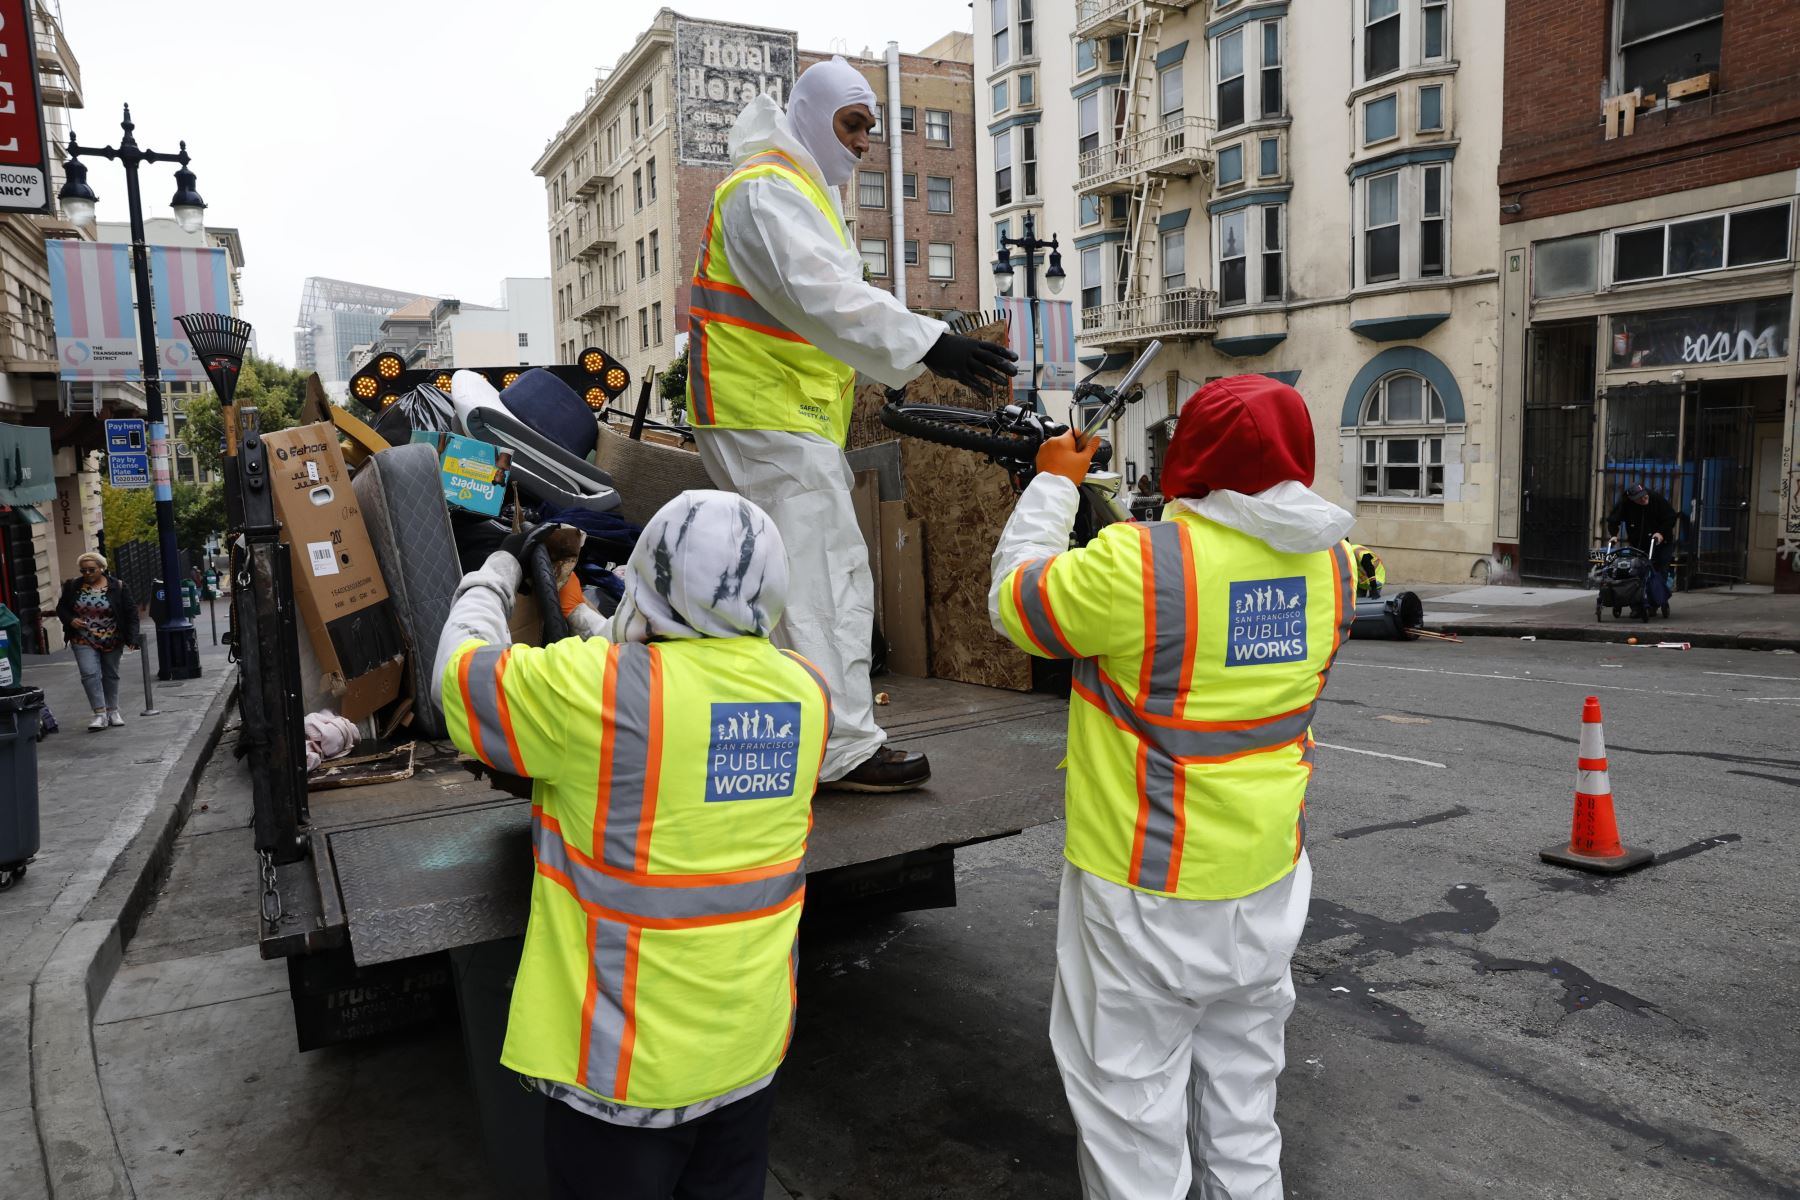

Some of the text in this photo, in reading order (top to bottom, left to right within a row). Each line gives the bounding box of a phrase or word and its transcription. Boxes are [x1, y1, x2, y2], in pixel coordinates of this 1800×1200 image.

[702, 35, 772, 74] Hotel
[693, 111, 723, 124] STEEL
[694, 131, 714, 141] 200
[699, 143, 724, 154] BATH
[0, 173, 38, 185] ROOMS
[108, 422, 142, 431] Pay here
[112, 456, 126, 464] Pay
[450, 476, 495, 500] Pampers
[60, 490, 72, 534] HOTEL
[1235, 611, 1301, 624] SAN FRANCISCO
[1234, 620, 1302, 642] PUBLIC
[1234, 639, 1303, 661] WORKS
[716, 741, 794, 751] SAN FRANCISCO
[714, 751, 793, 772] PUBLIC
[714, 772, 791, 795] WORKS
